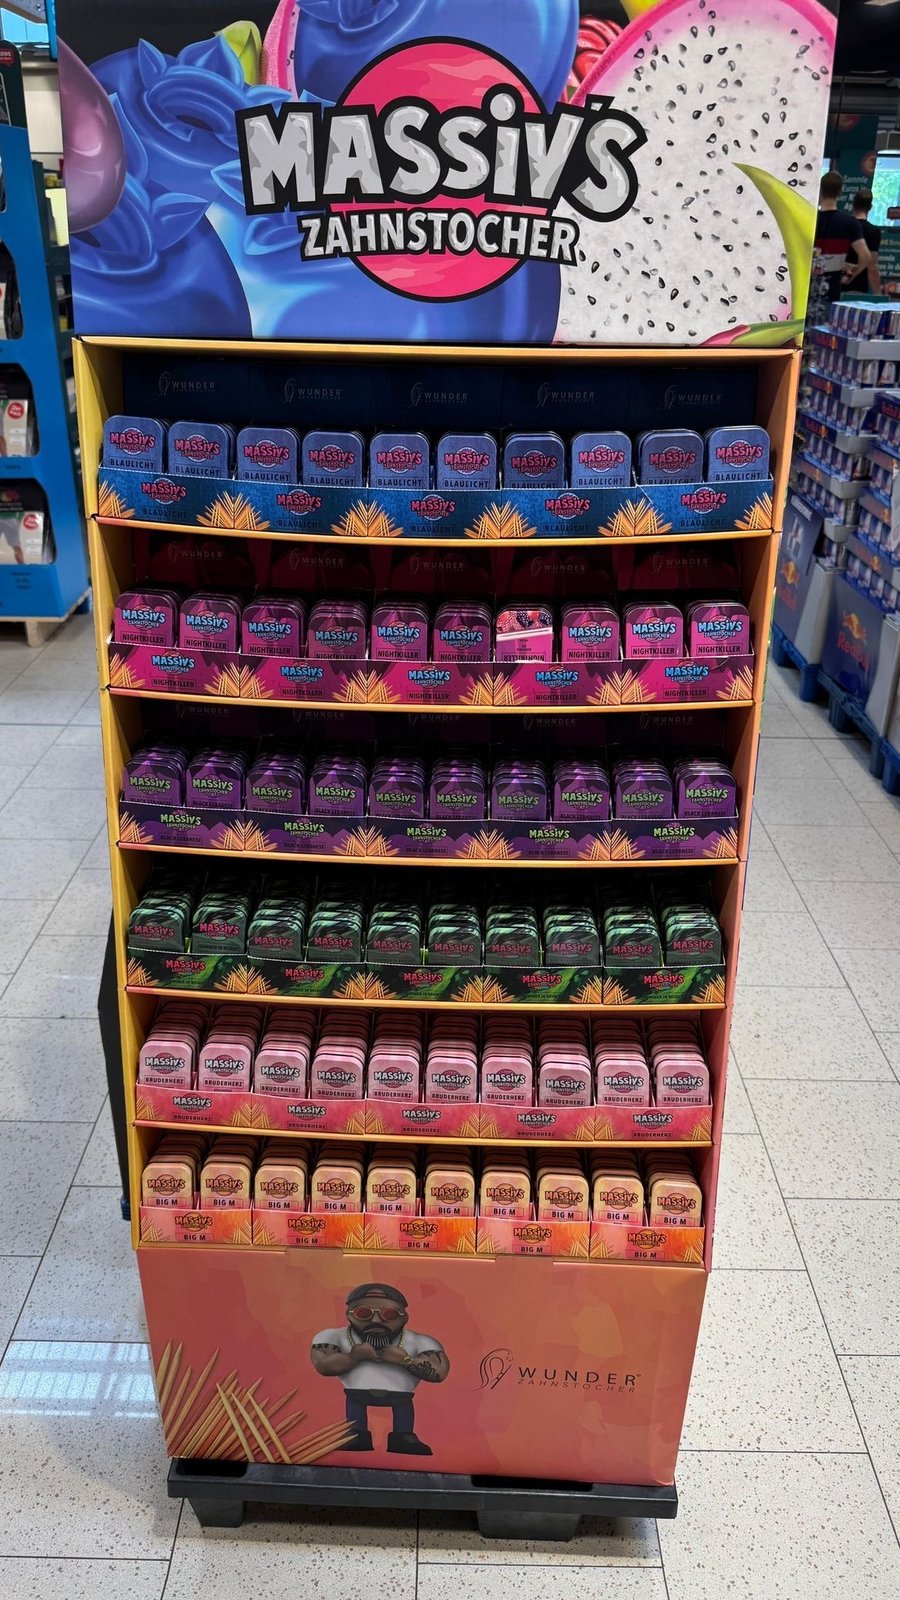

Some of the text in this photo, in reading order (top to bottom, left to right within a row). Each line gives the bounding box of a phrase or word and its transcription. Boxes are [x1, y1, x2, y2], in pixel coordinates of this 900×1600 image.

[299, 209, 579, 264] ZAHNSTOCHER
[172, 381, 216, 389] WUNDER
[298, 388, 342, 396] WUNDER
[424, 392, 468, 400] WUNDER
[110, 459, 154, 470] BLAULICHT
[176, 466, 219, 477] BLAULICHT
[244, 472, 290, 482] BLAULICHT
[310, 476, 354, 486] BLAULICHT
[716, 472, 760, 481] BLAULICHT
[377, 478, 422, 487] BLAULICHT
[444, 479, 488, 488] BLAULICHT
[578, 478, 624, 486] BLAULICHT
[122, 634, 164, 644] NIGHTKILLER
[186, 640, 226, 650] NIGHTKILLER
[250, 646, 290, 654] NIGHTKILLER
[378, 650, 418, 658] NIGHTKILLER
[698, 646, 741, 654] NIGHTKILLER
[152, 678, 194, 688] NIGHTKILLER
[408, 692, 450, 700] NIGHTKILLER
[146, 1076, 184, 1084] BRUDERHERZ
[205, 1079, 242, 1087] BRUDERHERZ
[374, 1090, 412, 1098] BRUDERHERZ
[546, 1098, 584, 1106] BRUDERHERZ
[518, 1366, 636, 1386] WUNDER
[517, 1378, 636, 1393] ZAHNSTOCHER
